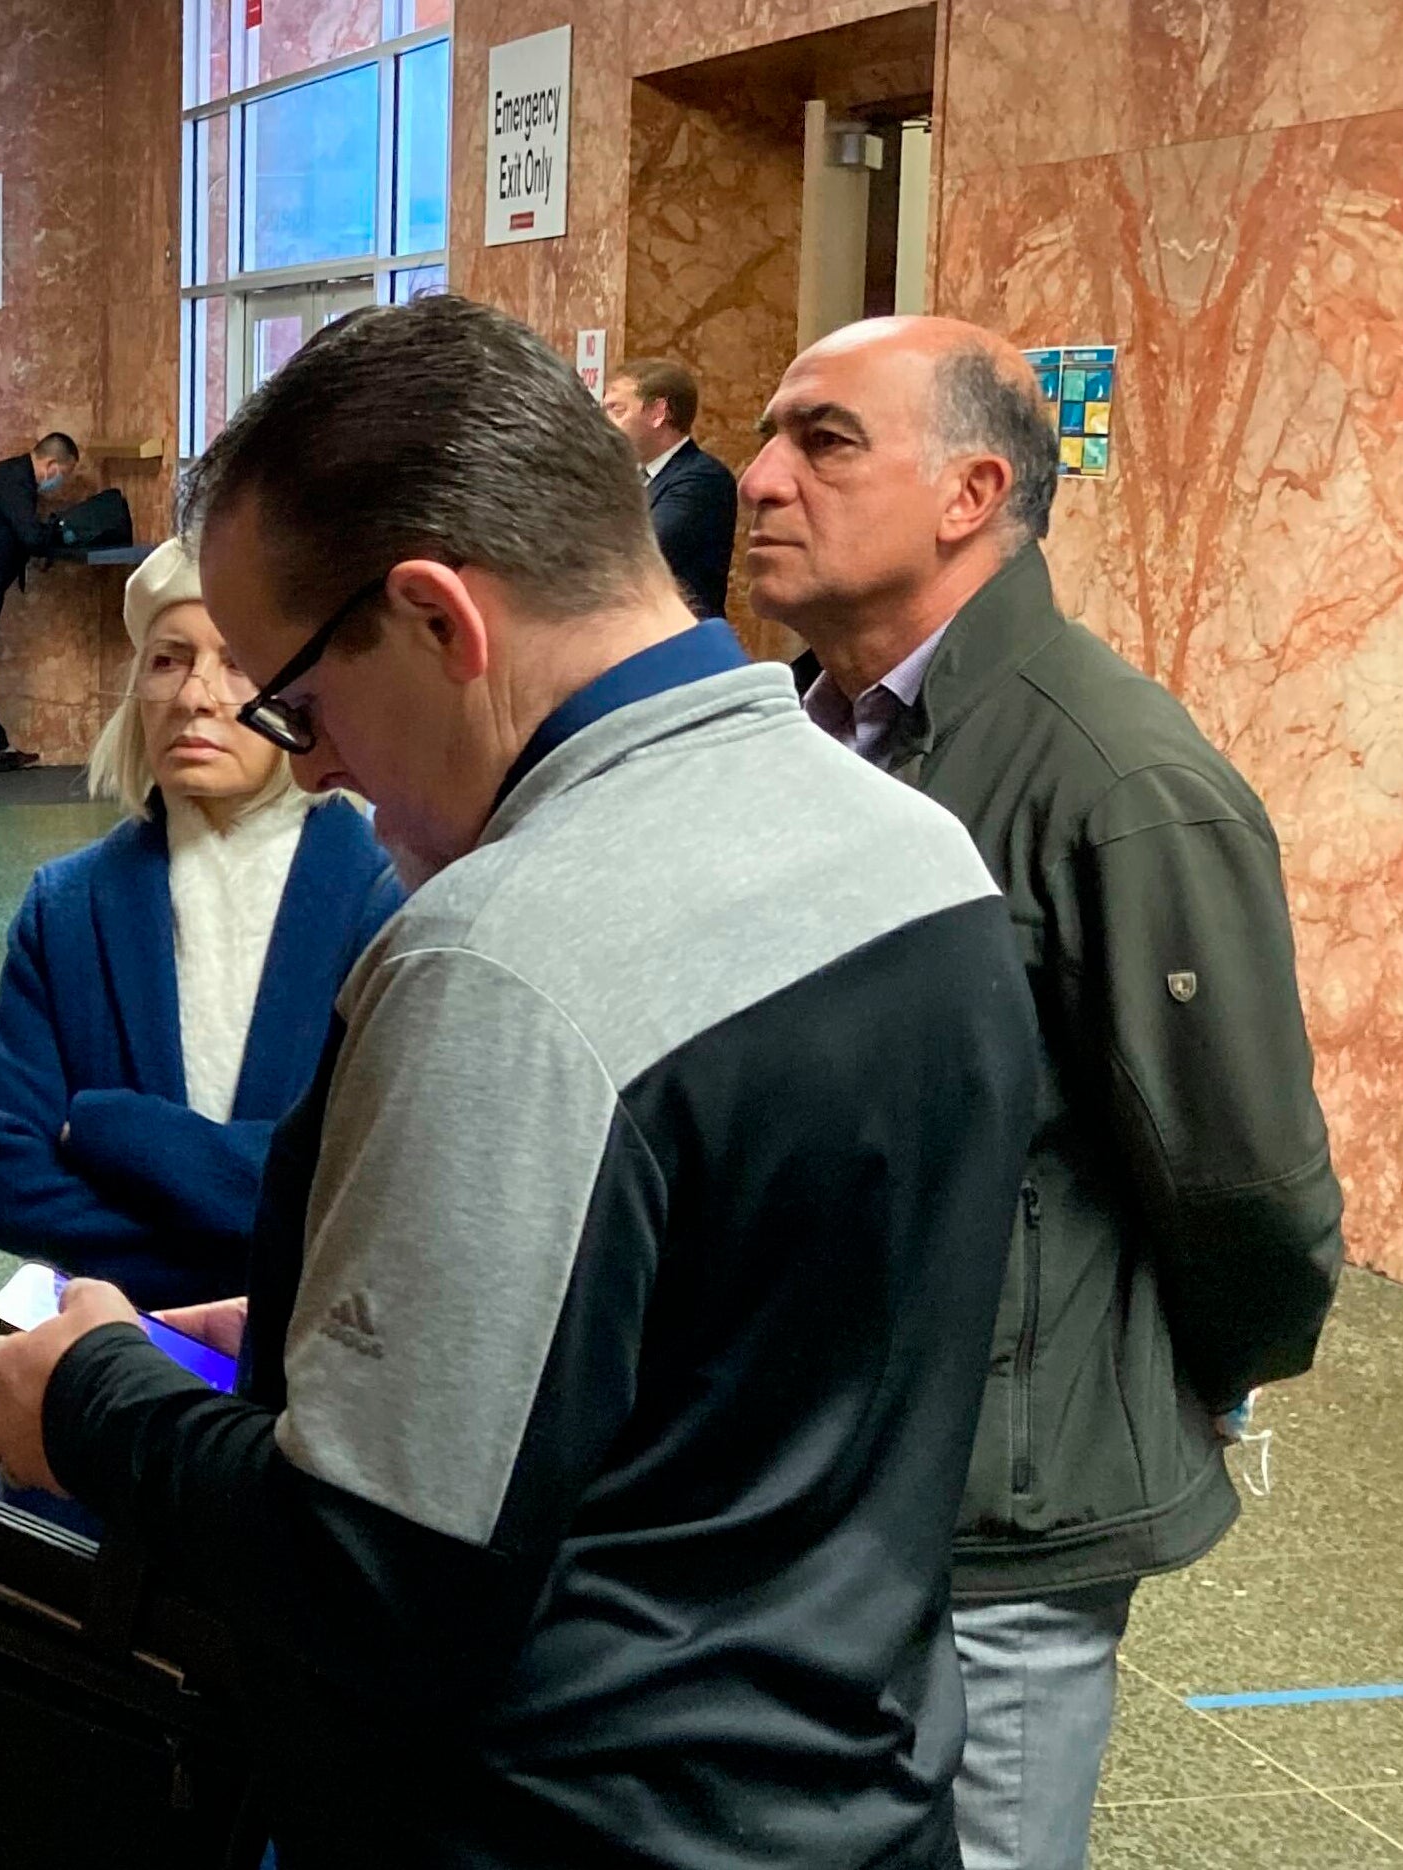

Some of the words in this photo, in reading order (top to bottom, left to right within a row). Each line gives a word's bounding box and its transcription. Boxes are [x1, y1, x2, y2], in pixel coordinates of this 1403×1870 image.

[494, 85, 561, 142] Emergency
[499, 152, 521, 200] Exit
[524, 146, 552, 205] Only
